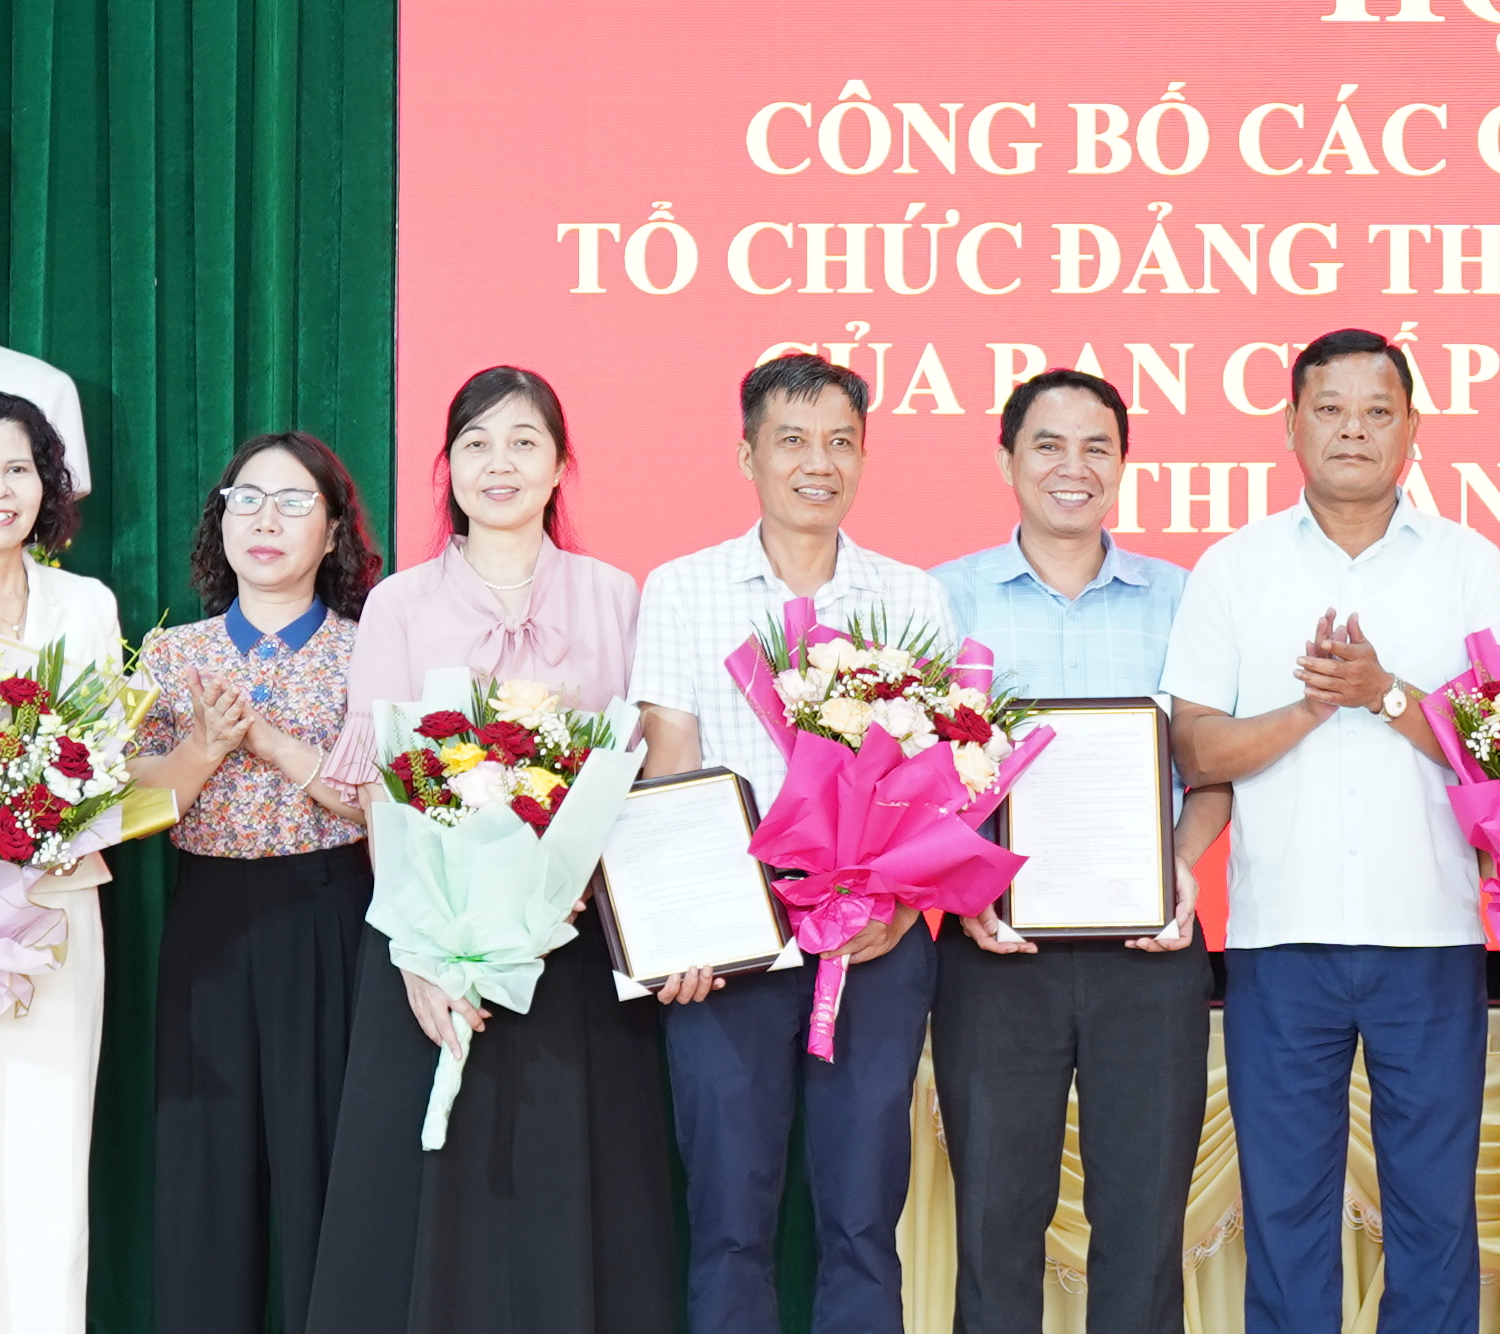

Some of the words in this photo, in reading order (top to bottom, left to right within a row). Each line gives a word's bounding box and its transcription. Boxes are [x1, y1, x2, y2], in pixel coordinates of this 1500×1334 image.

[746, 79, 1042, 175] CÔNG
[1068, 80, 1209, 176] BỐ
[1239, 83, 1448, 177] CÁC
[557, 200, 698, 295] TỔ
[728, 202, 1022, 295] CHỨC
[1051, 201, 1344, 296] ĐẢNG
[1223, 321, 1500, 415] CẤP
